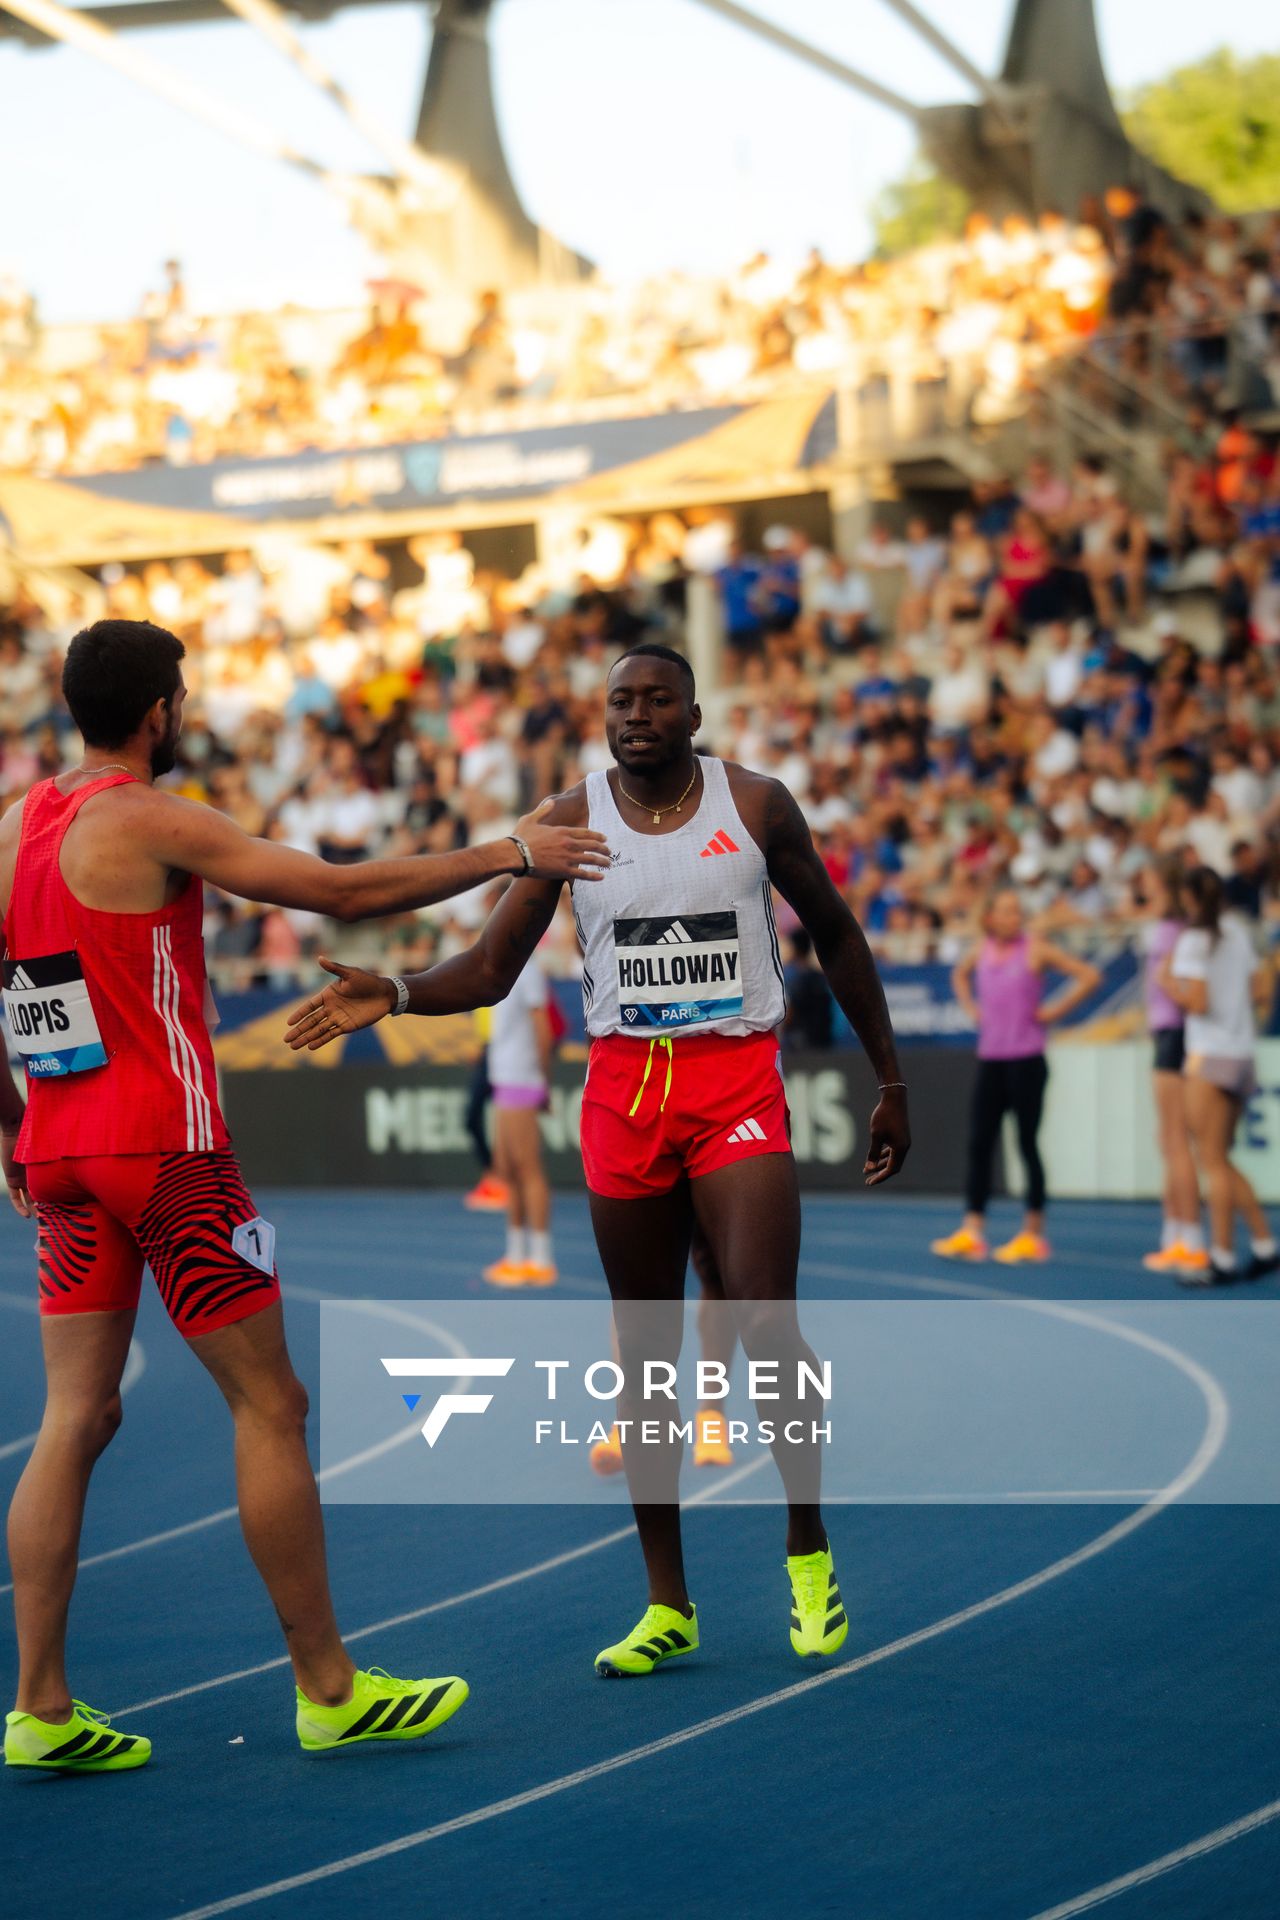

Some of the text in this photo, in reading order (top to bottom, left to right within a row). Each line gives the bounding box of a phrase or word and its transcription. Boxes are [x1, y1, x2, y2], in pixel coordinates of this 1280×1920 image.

[618, 951, 738, 988] HOLLOWAY
[661, 1007, 700, 1020] PARIS
[28, 1058, 61, 1073] PARIS
